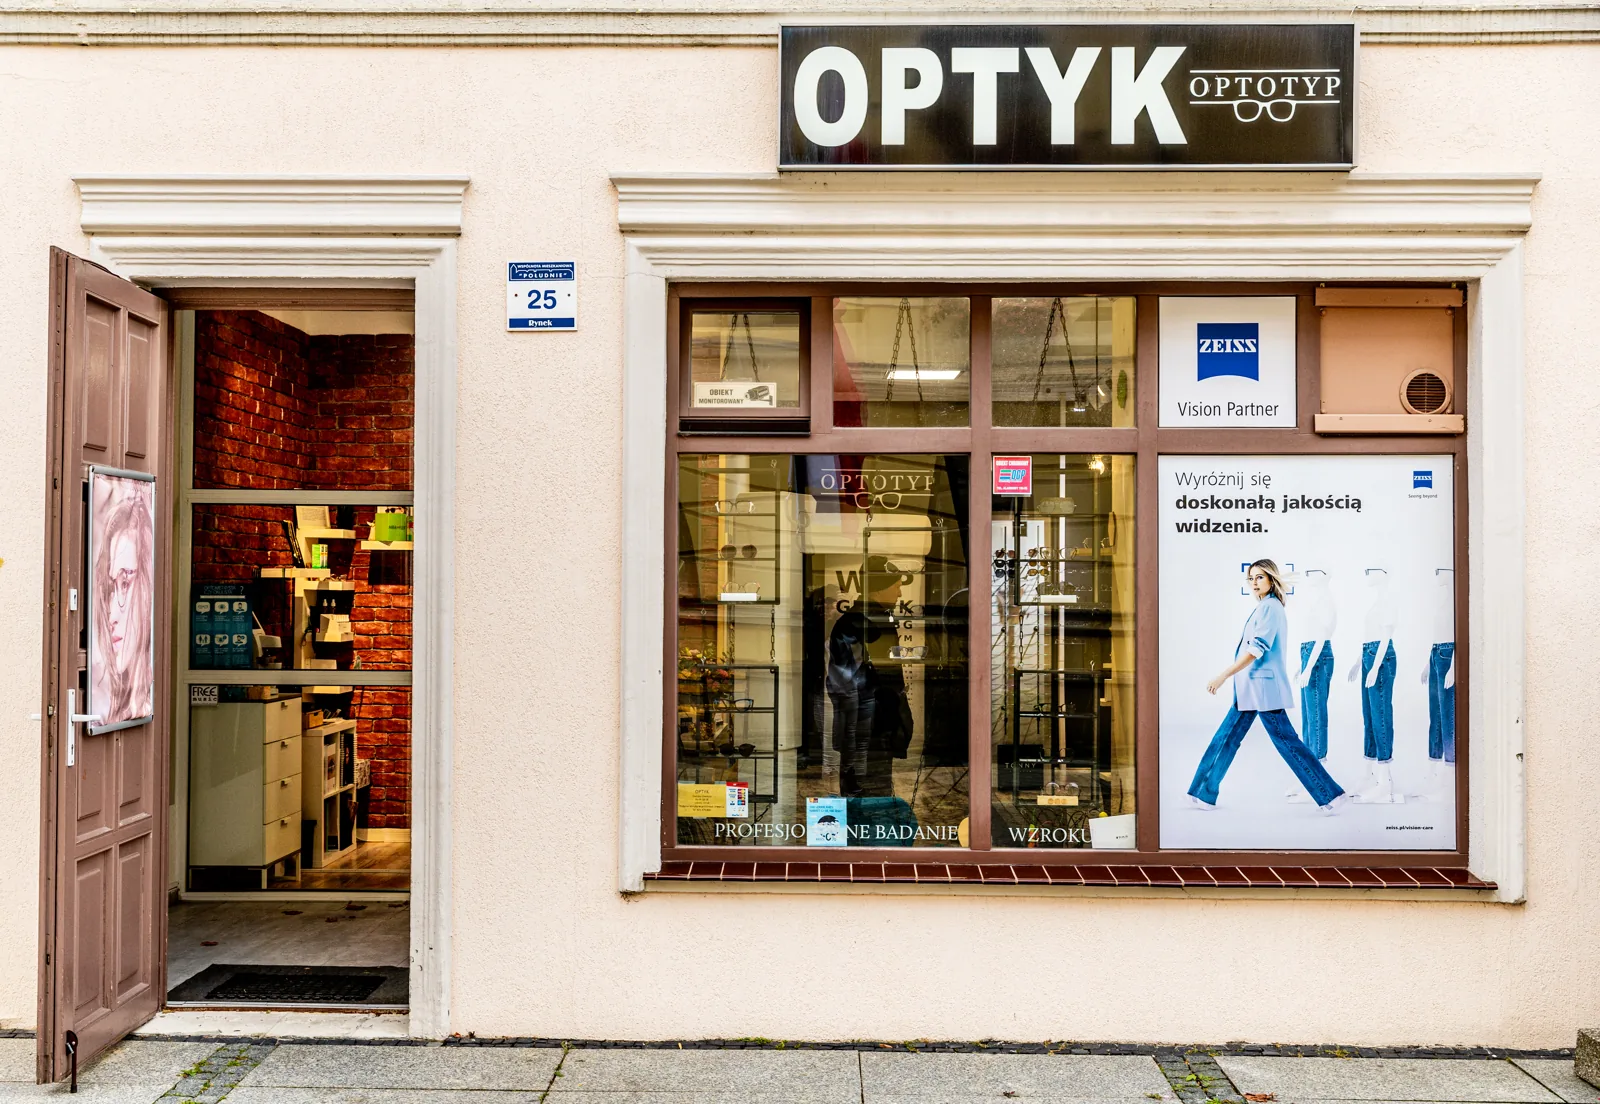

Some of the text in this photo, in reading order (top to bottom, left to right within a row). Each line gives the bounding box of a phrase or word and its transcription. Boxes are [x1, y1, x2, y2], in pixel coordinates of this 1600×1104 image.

[793, 45, 1188, 147] OPTYK
[1189, 76, 1342, 99] OPTOTYP
[527, 289, 557, 310] 25
[528, 319, 553, 328] Rynek
[1199, 338, 1257, 353] ZEISS
[709, 388, 734, 396] OBIEKT
[1177, 401, 1279, 417] Vision Partner
[821, 473, 935, 491] OPTOTYP
[1175, 471, 1272, 490] Wyróżnij się
[1175, 494, 1362, 514] doskonałą jakością
[1175, 518, 1269, 533] widzenia.
[192, 686, 217, 697] FREE
[714, 822, 959, 841] PROFESJONE BADANIE
[1008, 827, 1093, 843] WZROKU
